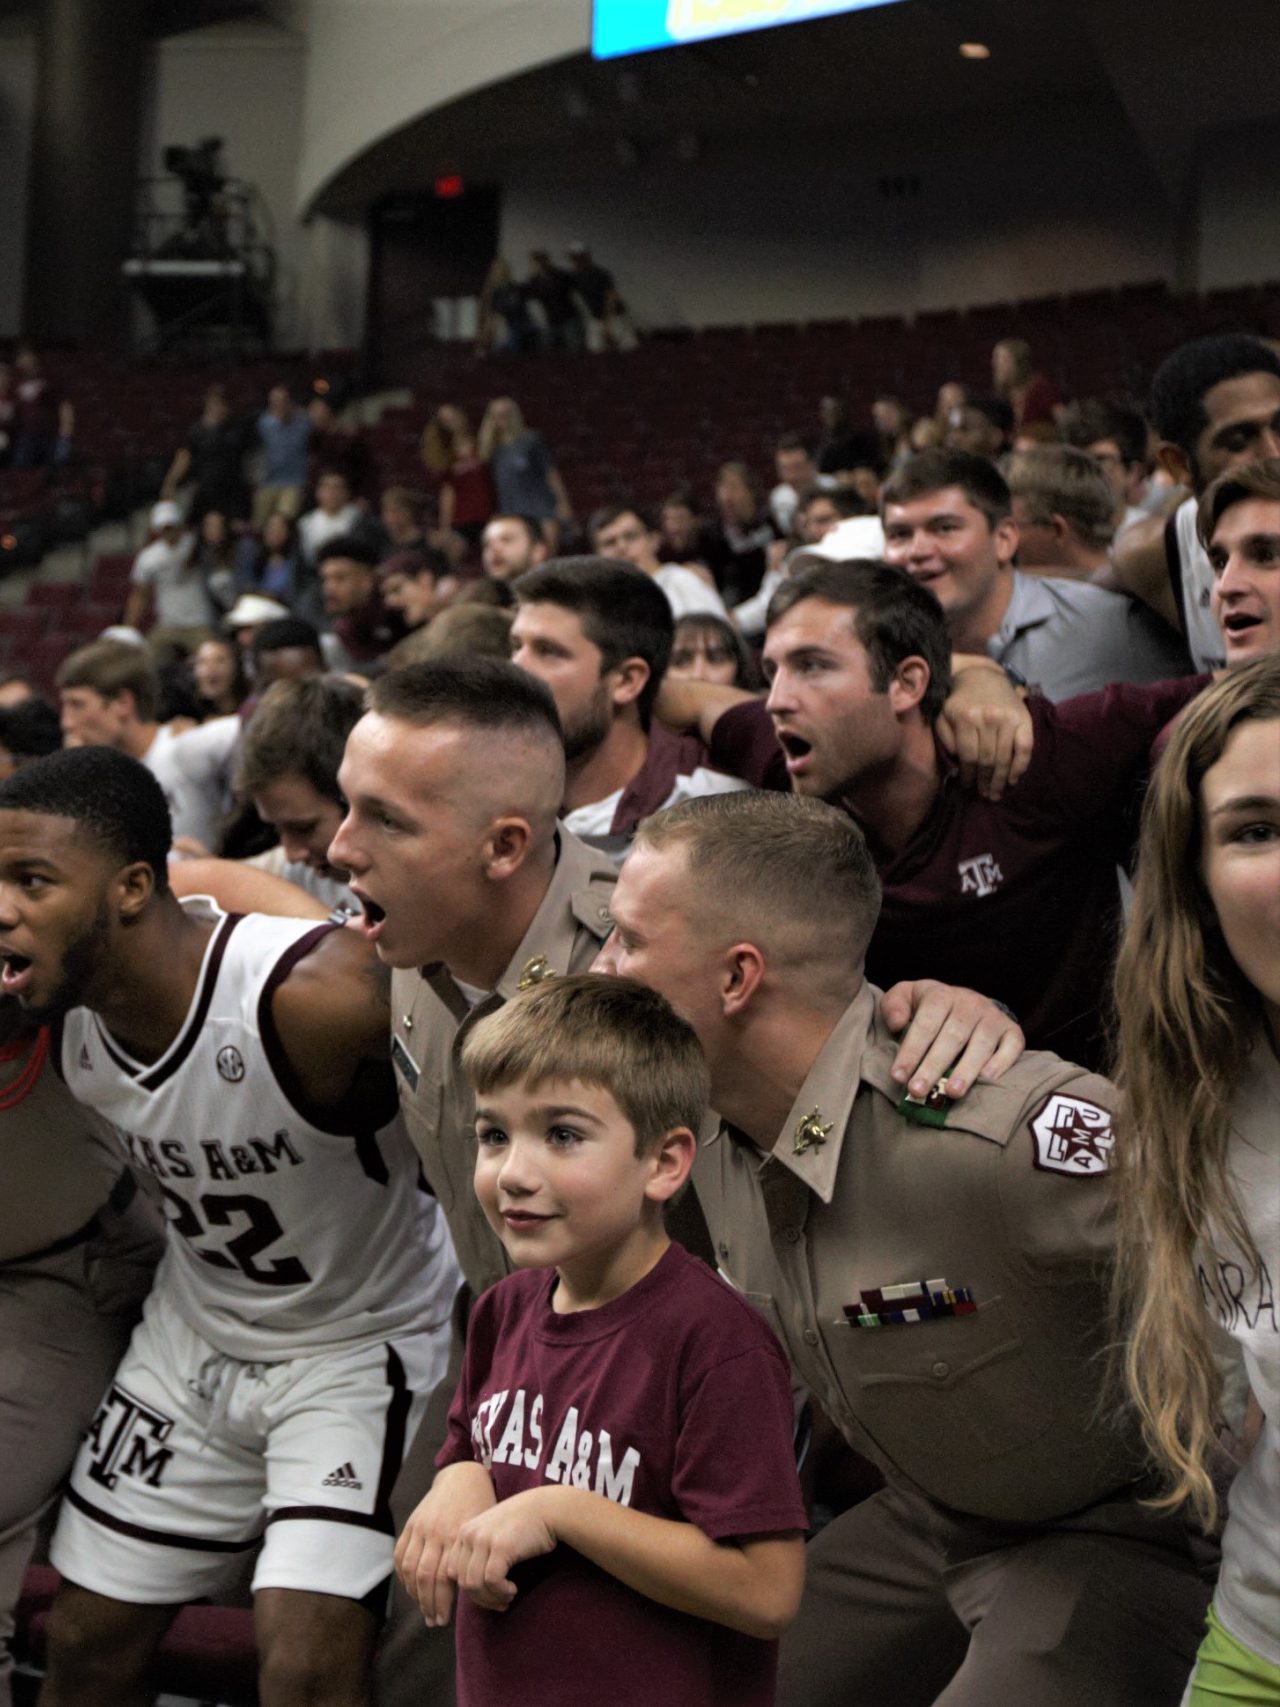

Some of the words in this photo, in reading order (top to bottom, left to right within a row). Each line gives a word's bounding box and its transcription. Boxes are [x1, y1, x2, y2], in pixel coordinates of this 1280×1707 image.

[200, 1128, 305, 1180] A&M
[545, 1406, 642, 1508] A&M
[321, 1478, 363, 1491] adidas
